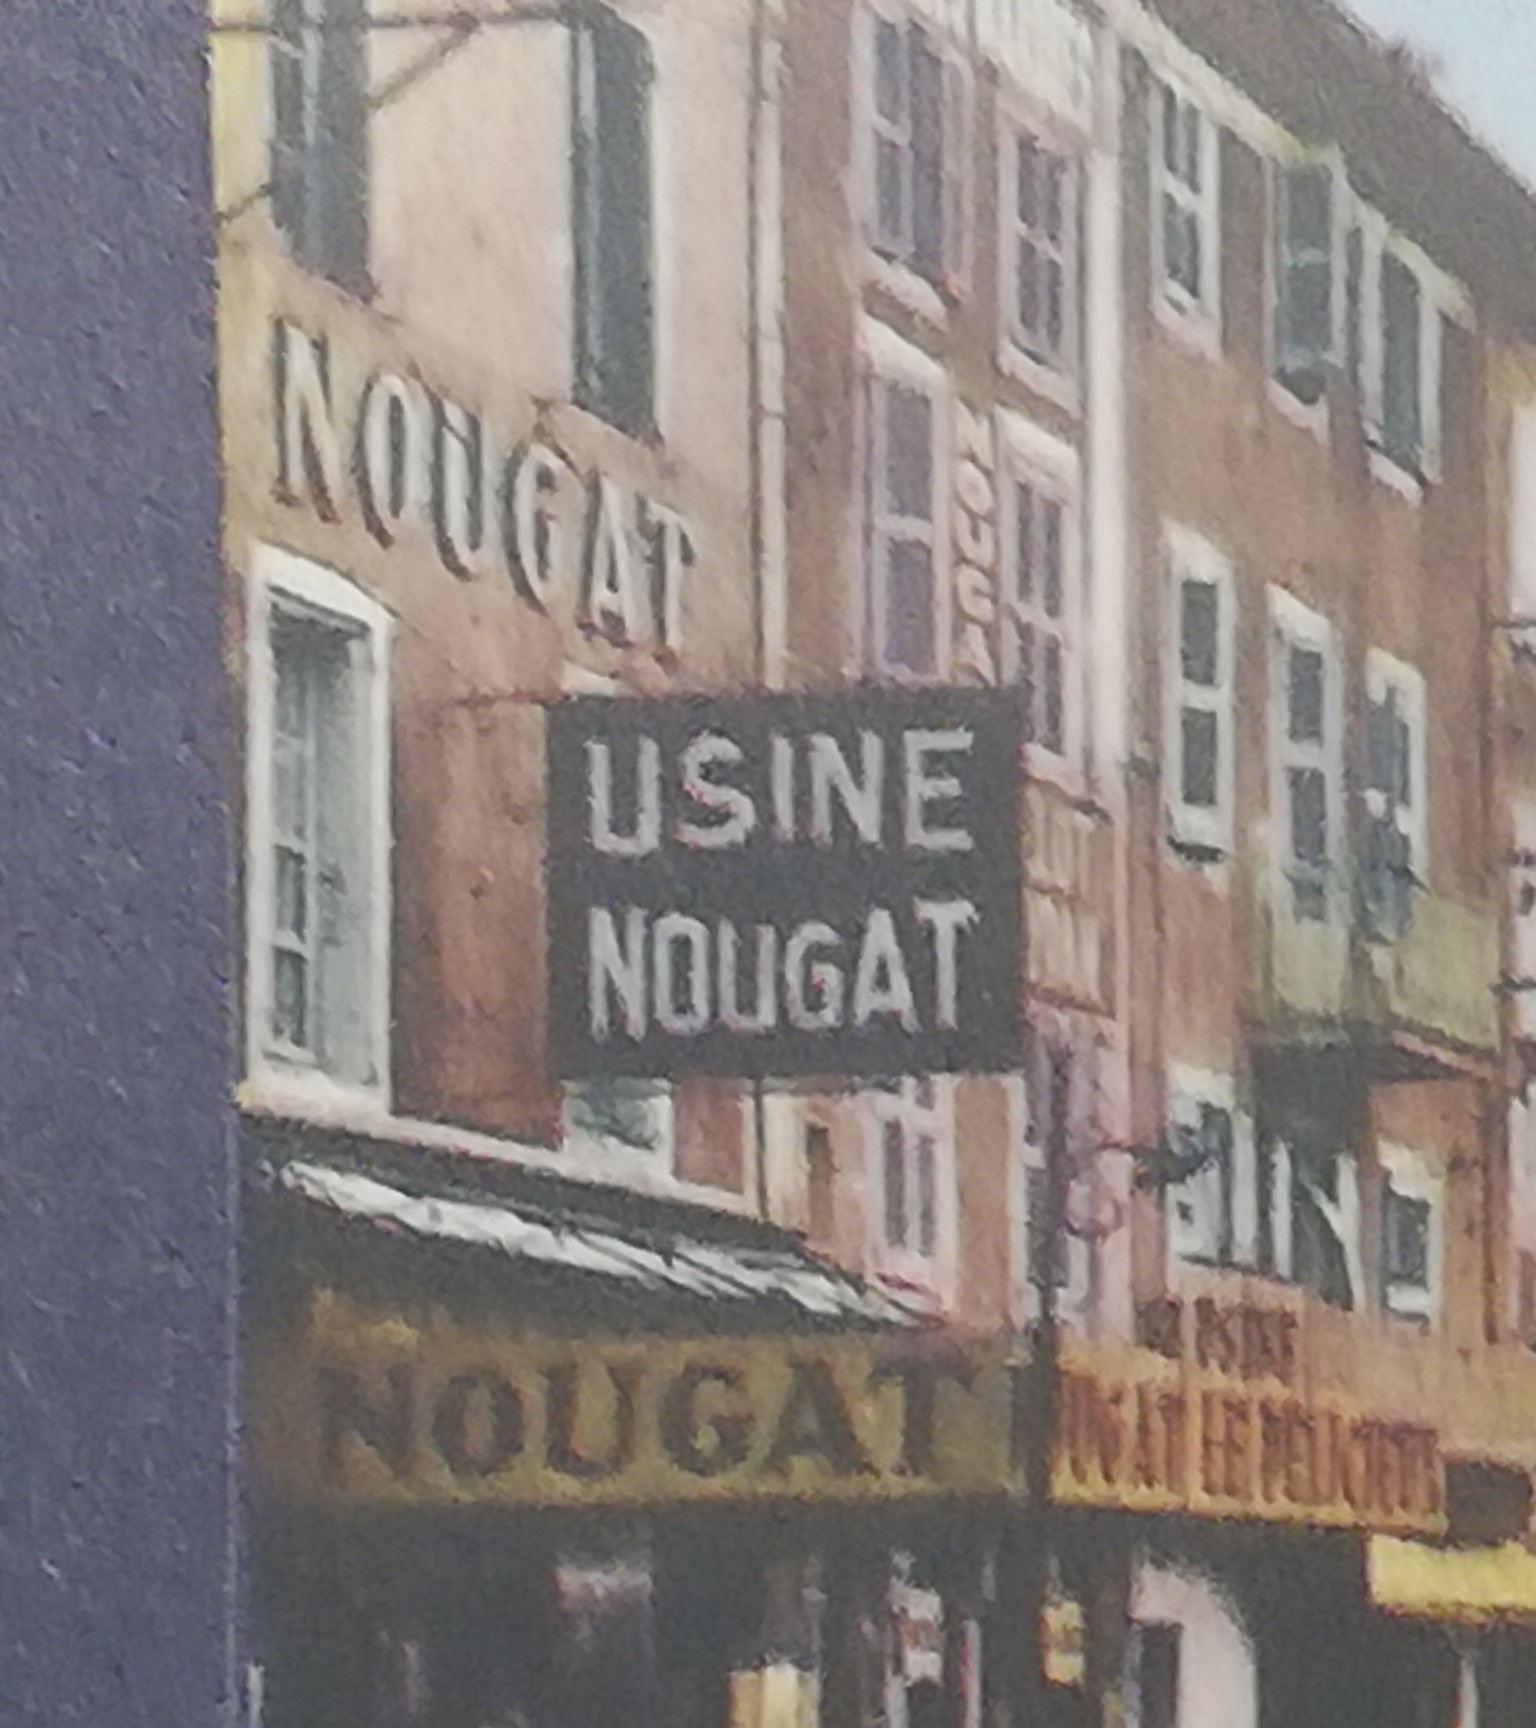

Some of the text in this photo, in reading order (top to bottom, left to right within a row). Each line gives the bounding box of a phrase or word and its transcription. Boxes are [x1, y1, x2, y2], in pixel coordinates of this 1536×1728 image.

[273, 318, 697, 668] NOUGAT
[584, 728, 976, 858] USINE
[587, 897, 980, 1043] NOUGAT
[315, 1352, 975, 1482] NOUGAT
